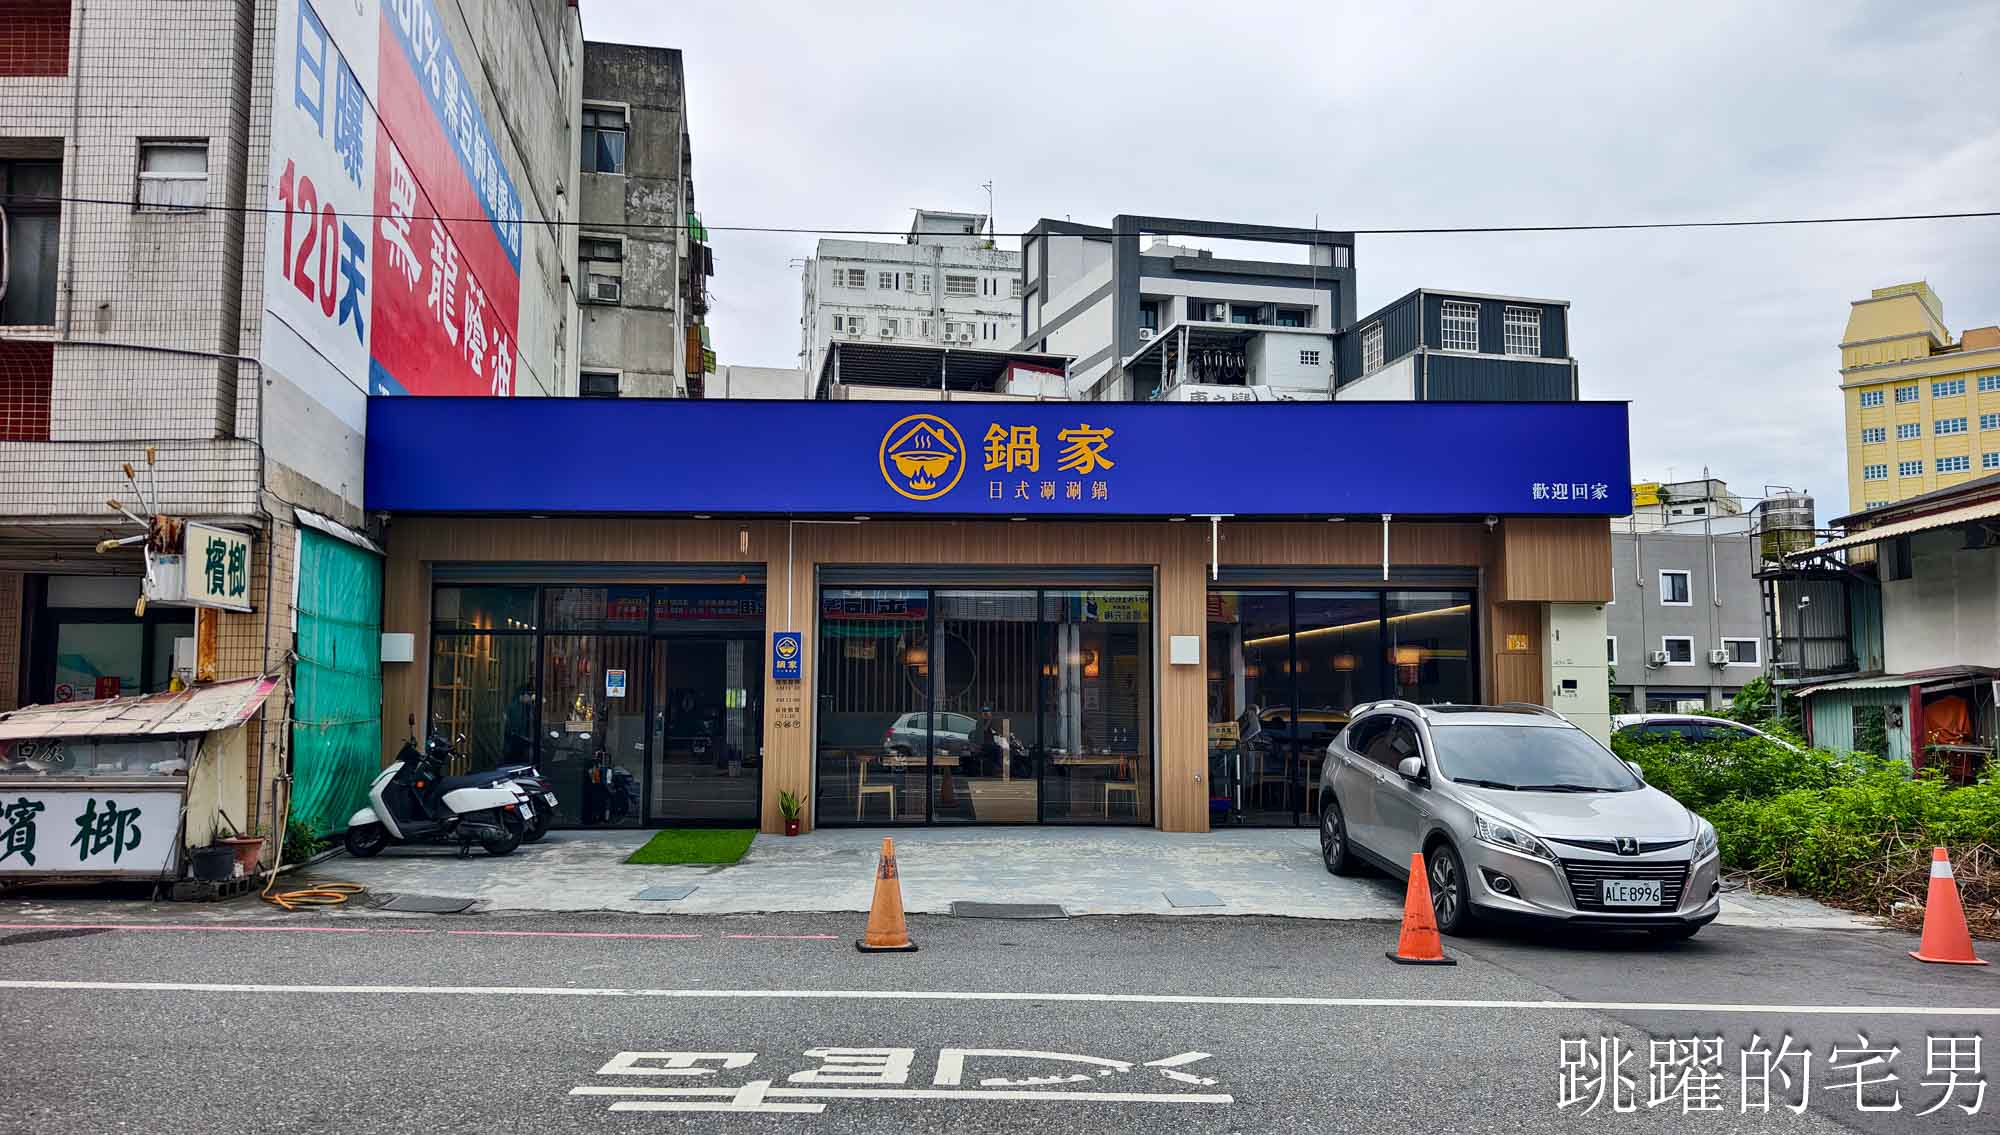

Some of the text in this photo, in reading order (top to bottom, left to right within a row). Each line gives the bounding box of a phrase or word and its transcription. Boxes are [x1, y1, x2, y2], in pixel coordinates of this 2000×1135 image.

[391, 0, 440, 98] 00%
[295, 3, 363, 187] 日曝
[279, 158, 365, 346] 120天
[983, 423, 1116, 475] 鍋家
[989, 481, 1109, 501] 日式涮涮鍋
[1532, 483, 1609, 500] 歡迎回家
[205, 535, 247, 598] 檳榔
